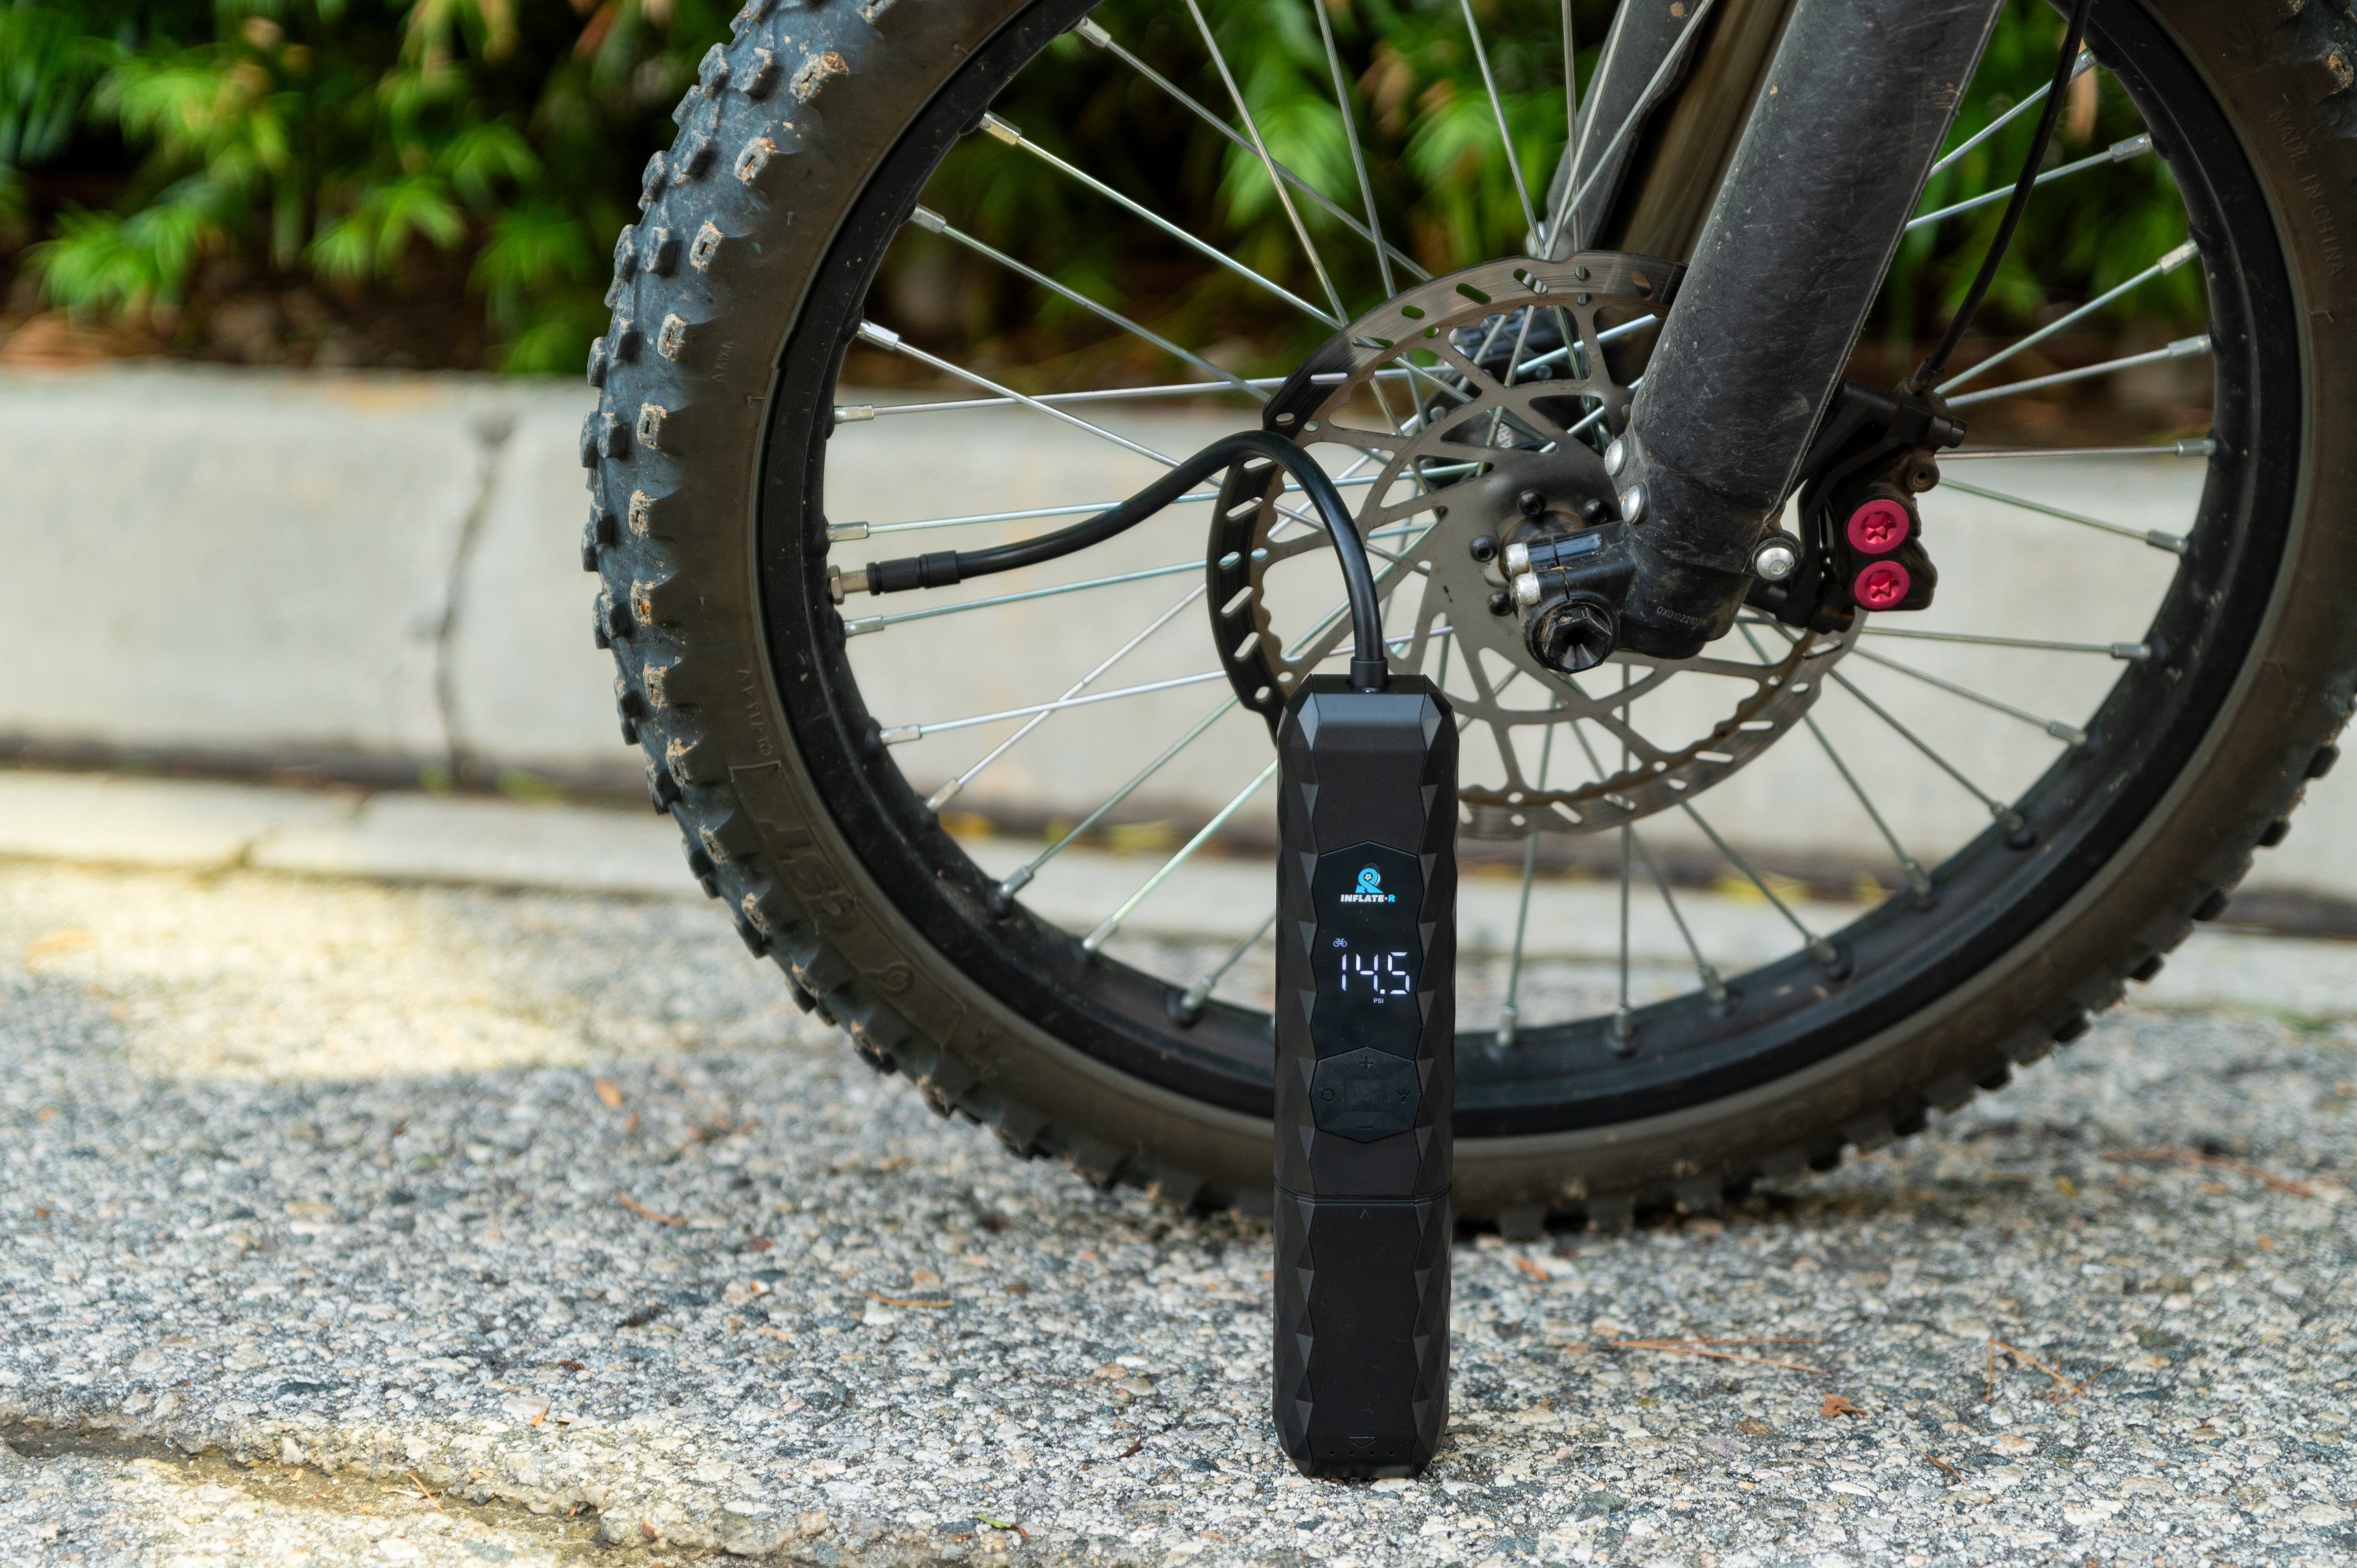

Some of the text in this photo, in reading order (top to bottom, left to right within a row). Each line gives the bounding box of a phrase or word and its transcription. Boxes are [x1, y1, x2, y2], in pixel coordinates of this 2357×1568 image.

[2269, 109, 2346, 277] MADE IN CHINA
[1342, 952, 1410, 994] 14.5
